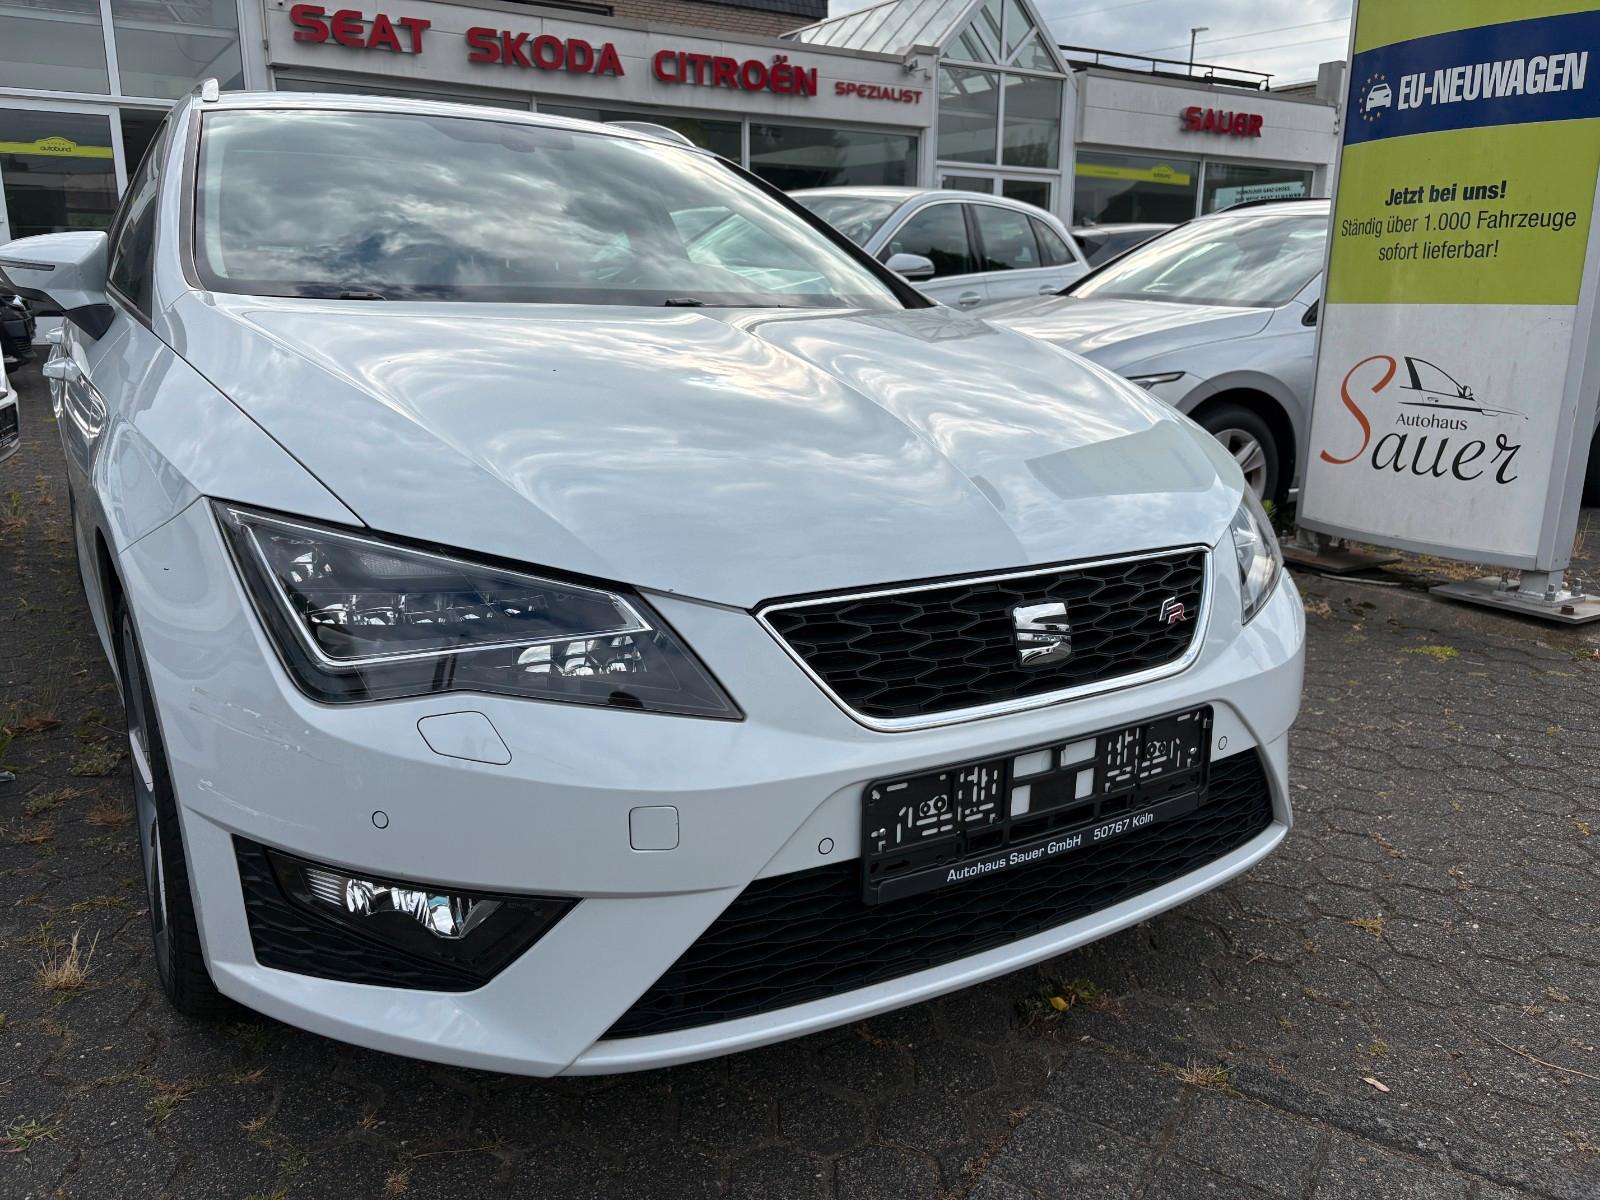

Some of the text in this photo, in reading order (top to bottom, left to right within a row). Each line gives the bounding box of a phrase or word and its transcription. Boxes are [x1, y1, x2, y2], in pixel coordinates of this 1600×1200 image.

[289, 4, 923, 104] SEAT SKODA CITROËN SPEZIALIST
[1397, 51, 1588, 110] EU-NEUWAGEN
[1182, 106, 1264, 138] SAUER
[1385, 180, 1507, 206] Jetzt bei uns!
[1341, 209, 1577, 238] Ständig über 1.000 Fahrzeuge
[1378, 240, 1499, 261] sofort lieferbar!
[1320, 355, 1521, 484] Sauer
[1395, 412, 1468, 431] Autohaus
[1159, 596, 1186, 624] FR
[947, 811, 1154, 882] Autohaus Sauer GmbH 50767 Köln
